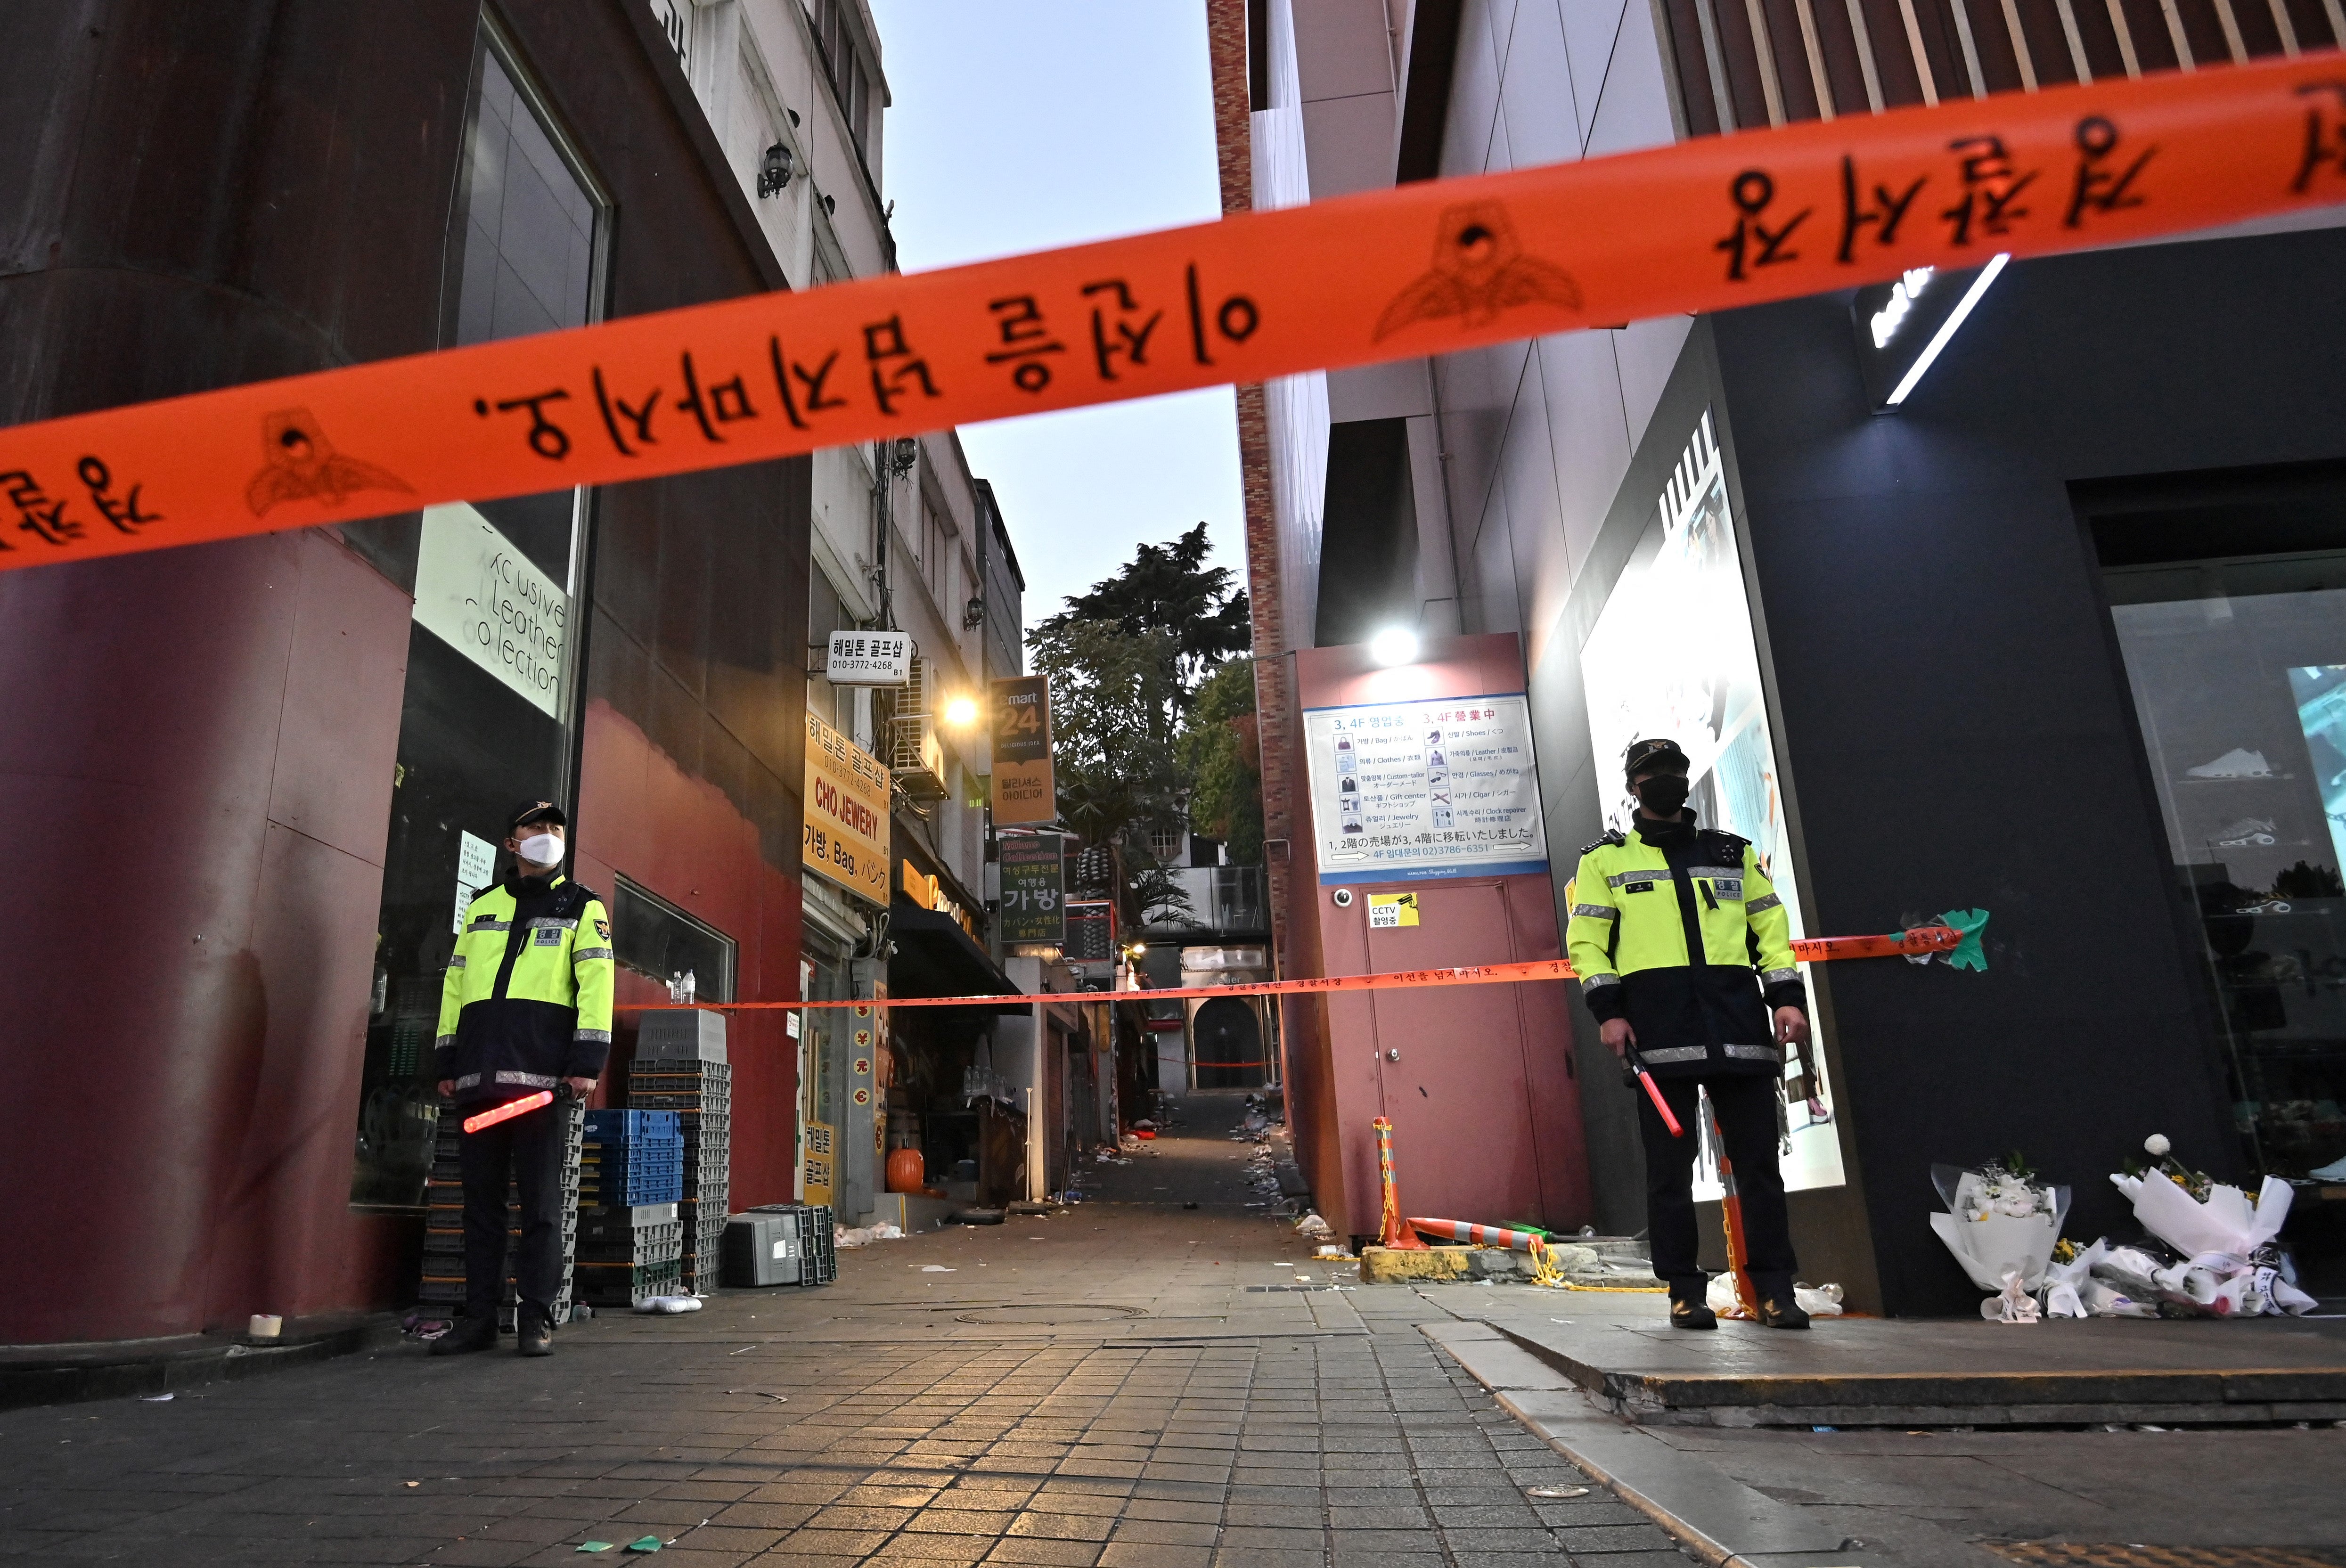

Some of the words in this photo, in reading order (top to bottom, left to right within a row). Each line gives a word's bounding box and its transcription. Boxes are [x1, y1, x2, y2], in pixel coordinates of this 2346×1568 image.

[1714, 114, 2161, 280] 경찰서장
[984, 261, 1260, 392] 이선을
[493, 580, 563, 663] Leather
[834, 639, 865, 657] 해밀톤
[870, 640, 903, 658] 골프샵
[832, 660, 892, 670] 010-3772-4268
[999, 705, 1041, 736] 24
[1334, 720, 1346, 730] 3,
[1350, 718, 1365, 728] 4F
[1369, 716, 1405, 728] 영업중
[1437, 712, 1452, 722] 4F
[809, 716, 846, 762] 해밀톤
[851, 748, 884, 791] 골프샵
[825, 755, 871, 797] 010-3772-4268
[1373, 780, 1417, 788] オーダーメード
[1002, 788, 1042, 801] 아이디어
[815, 776, 838, 817] CHO
[840, 793, 878, 842] JEWERY
[1375, 801, 1415, 809] ギフトショップ
[1503, 807, 1526, 815] repairer
[1392, 813, 1419, 821] Jewelry
[1474, 815, 1511, 823] 時計修理店
[804, 824, 830, 864] 가방,
[834, 840, 858, 879] Bag,
[883, 845, 888, 857] B1
[1003, 851, 1058, 863] Collection
[1373, 850, 1385, 858] 4F
[1386, 848, 1421, 858] 임대문의
[1422, 844, 1488, 856] 02)3786-6351
[1003, 864, 1059, 875] 여성구두전문
[1018, 877, 1046, 888] 여행용
[1716, 880, 1739, 890] 경찰
[883, 892, 888, 903] B1
[1004, 888, 1059, 910] 가방
[1372, 906, 1396, 915] CCTV
[1373, 916, 1397, 925] 촬영중
[539, 929, 560, 939] 경찰
[1393, 971, 1429, 982] 이선을
[1296, 978, 1343, 988] 경찰서장
[806, 1126, 830, 1155] 해밀톤
[806, 1159, 830, 1187] 골프샵
